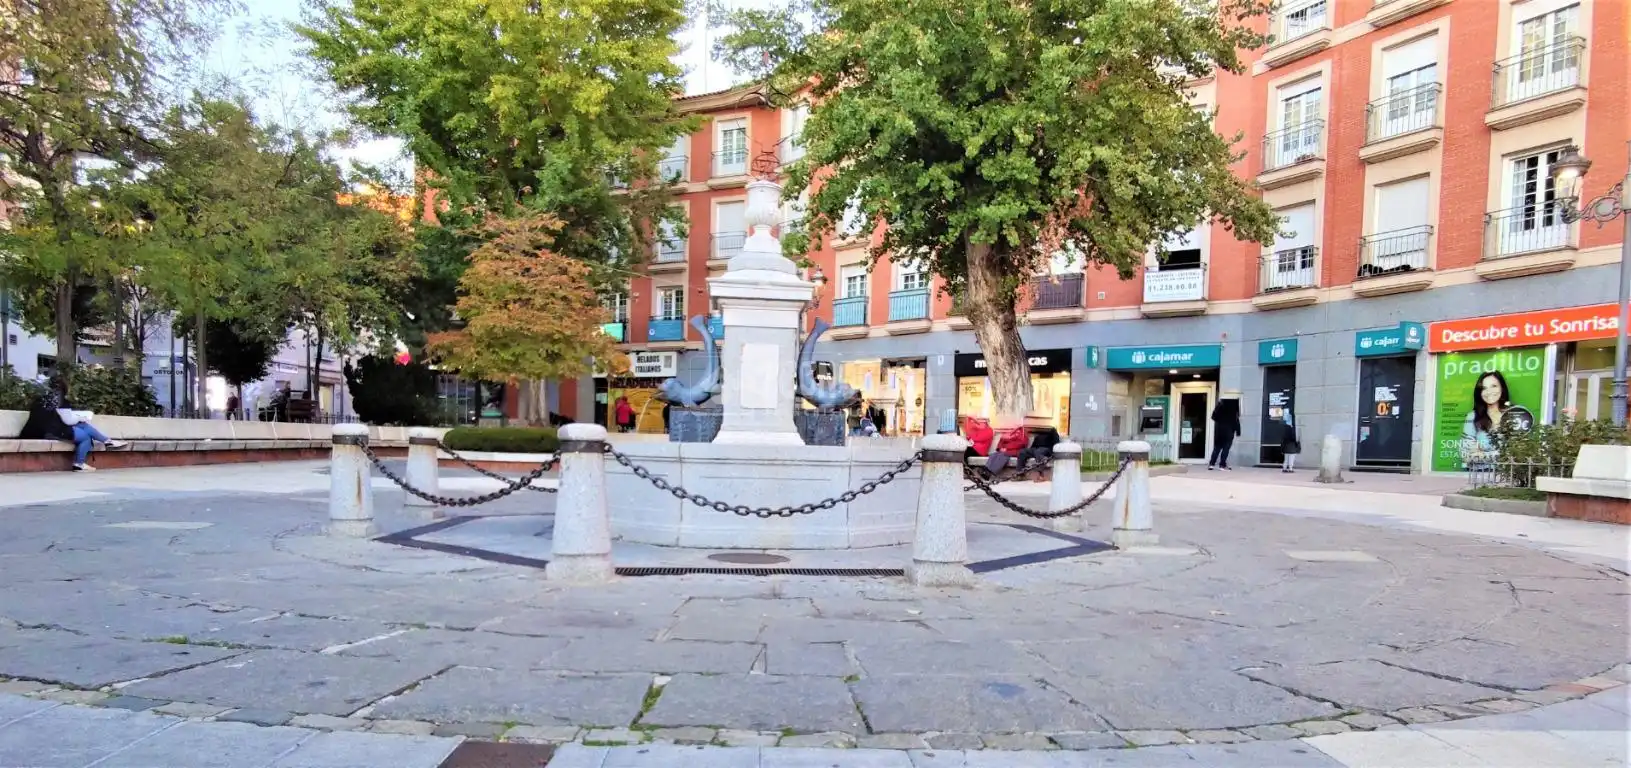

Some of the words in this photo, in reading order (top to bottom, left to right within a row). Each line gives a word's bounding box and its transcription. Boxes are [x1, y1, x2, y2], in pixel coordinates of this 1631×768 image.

[1442, 322, 1518, 344] Descubre
[1523, 322, 1544, 337] tu
[1550, 315, 1619, 334] Sonrisa
[636, 355, 661, 364] HELADOS
[1148, 351, 1194, 364] cajamar
[635, 365, 662, 373] ITALIANOS
[1444, 352, 1540, 379] pradillo
